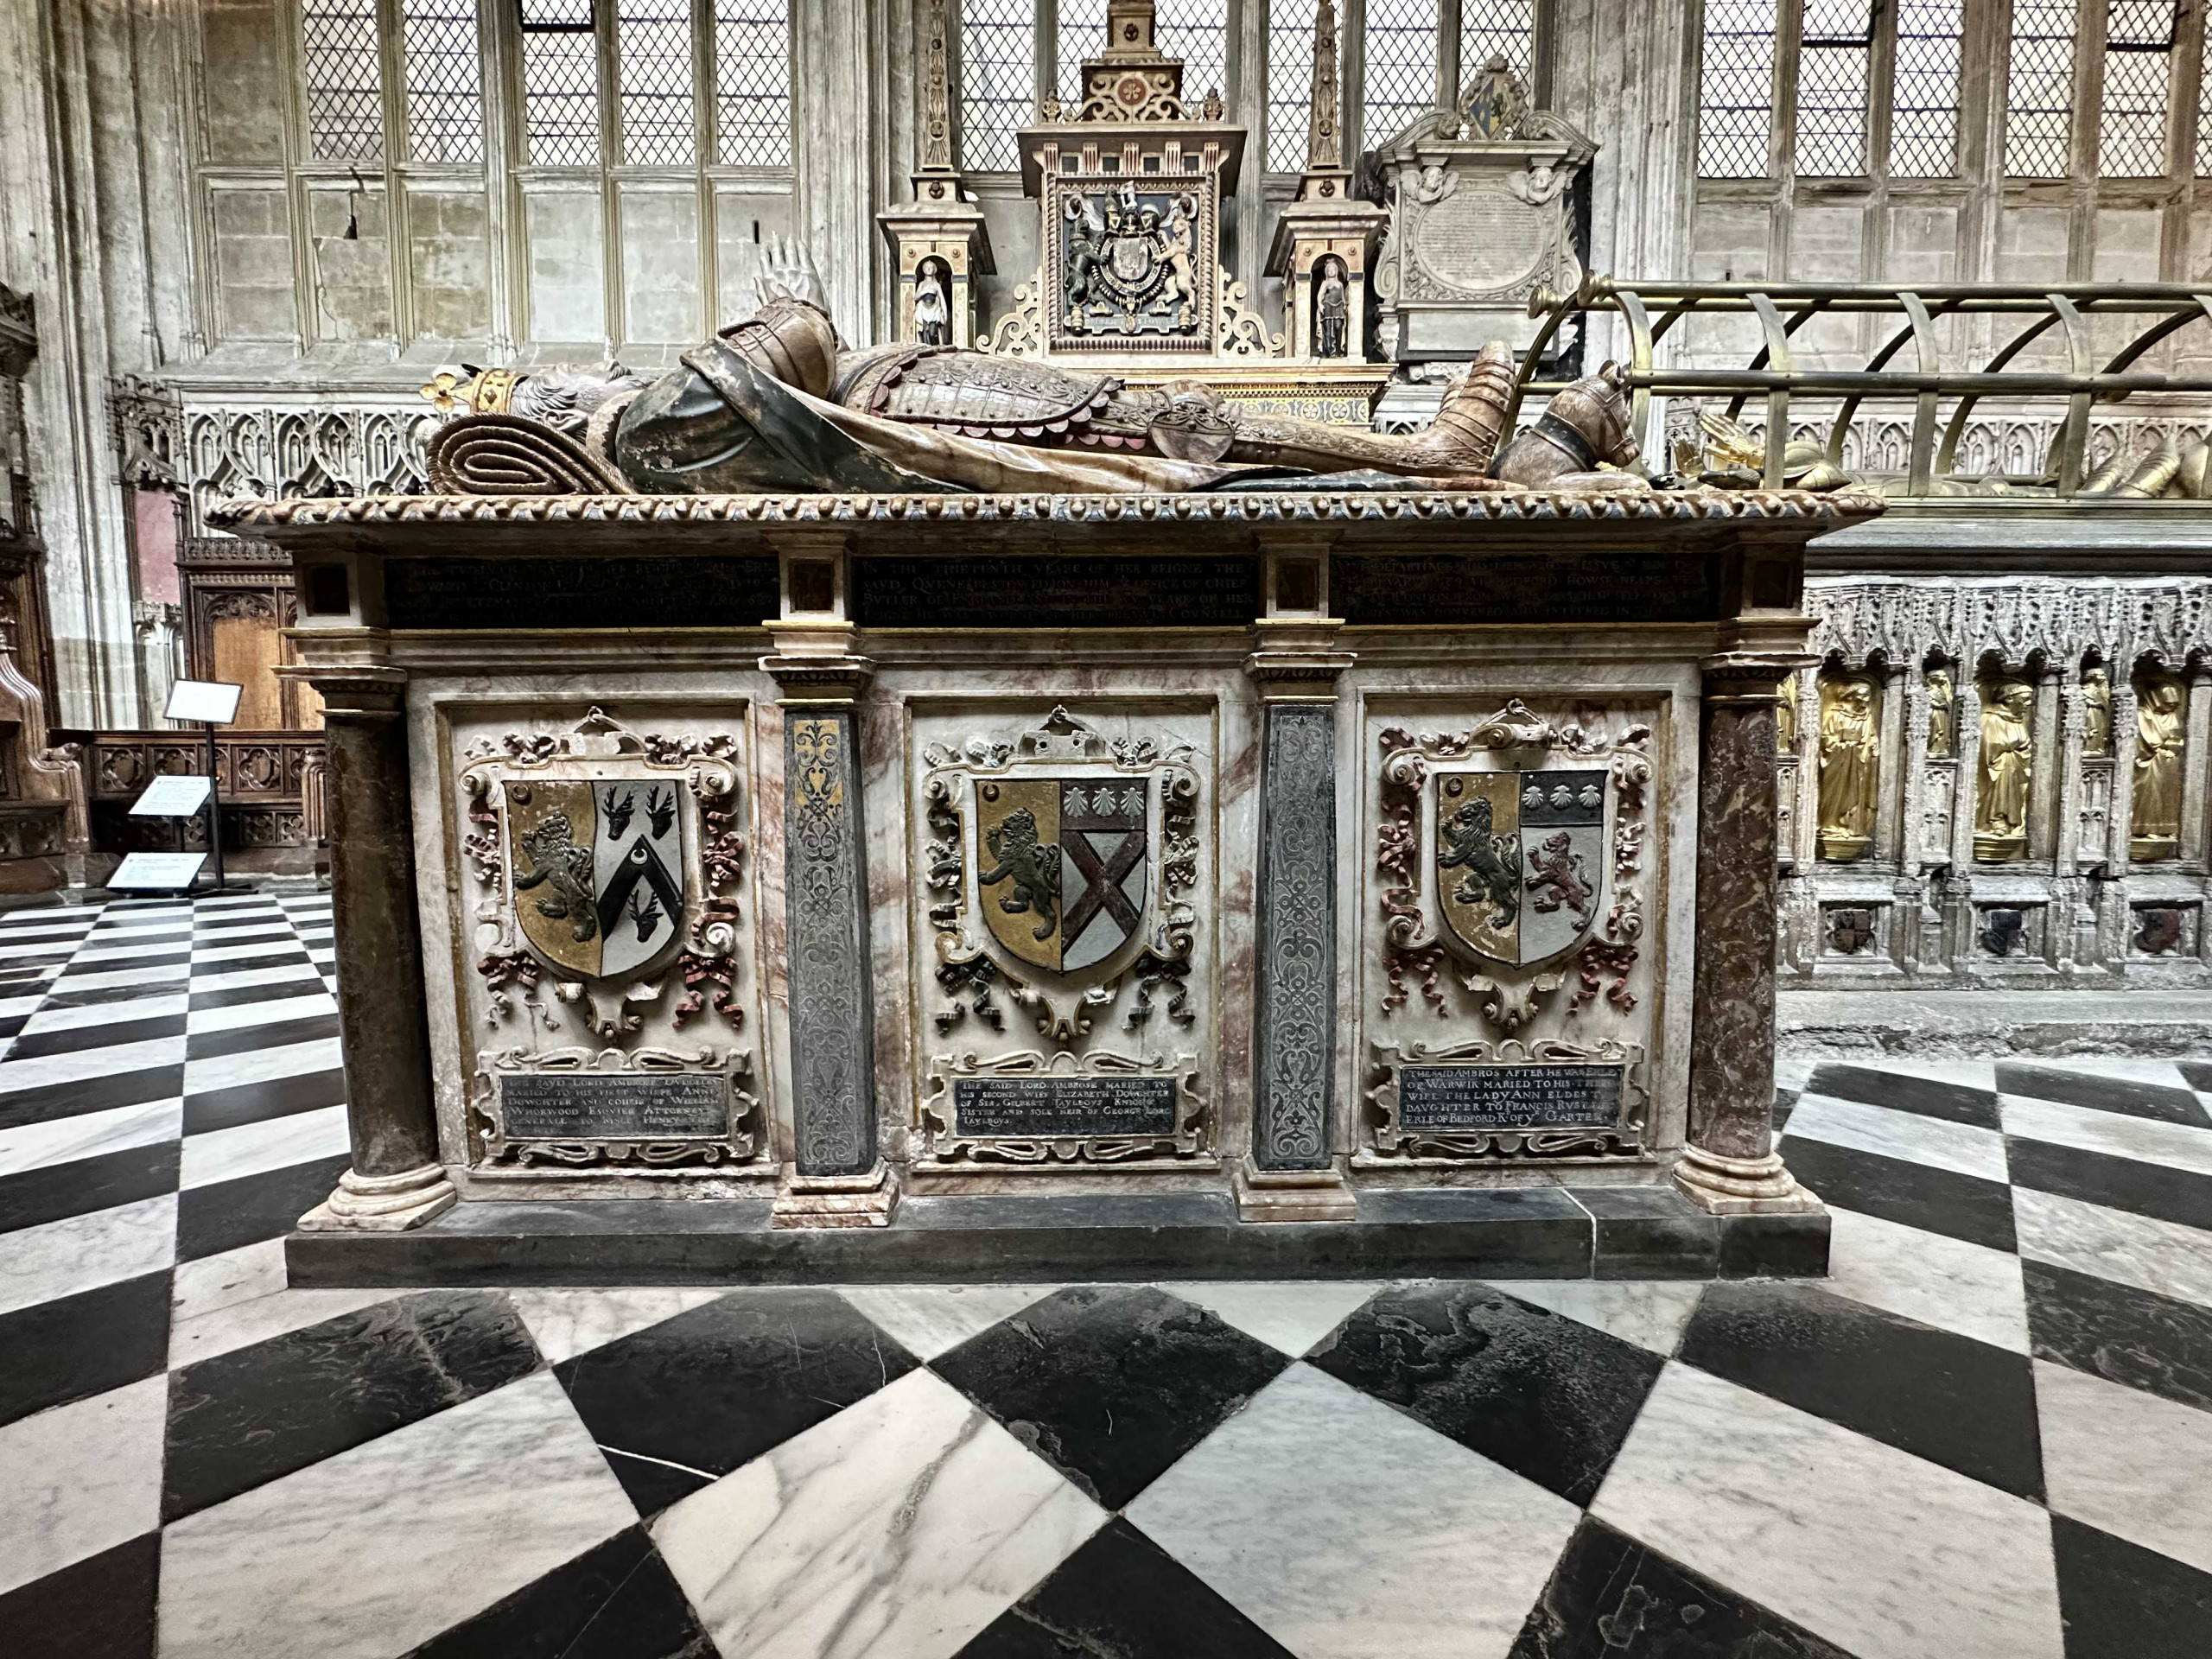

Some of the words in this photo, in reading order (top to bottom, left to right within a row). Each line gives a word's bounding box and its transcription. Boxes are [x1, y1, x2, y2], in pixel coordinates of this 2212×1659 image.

[1409, 1070, 1431, 1078] THE
[1432, 1070, 1453, 1078] SAID
[1454, 1068, 1500, 1078] AMBROS
[1505, 1068, 1543, 1077] AFTER
[1546, 1068, 1561, 1077] HE
[572, 1078, 604, 1087] LORD
[1020, 1081, 1046, 1090] LORD
[1050, 1081, 1098, 1090] AMBROSE
[1152, 1080, 1167, 1089] TO
[1426, 1078, 1479, 1090] WARWIK
[1484, 1079, 1531, 1090] MARIED
[1533, 1079, 1552, 1089] TO
[1056, 1089, 1110, 1098] ELIZABETH
[1473, 1090, 1511, 1104] LADY
[1510, 1090, 1541, 1100] ANN
[1484, 1102, 1503, 1111] TO
[1505, 1100, 1554, 1111] FRANCIS
[1405, 1115, 1435, 1124] ERLE
[1436, 1114, 1448, 1124] OF
